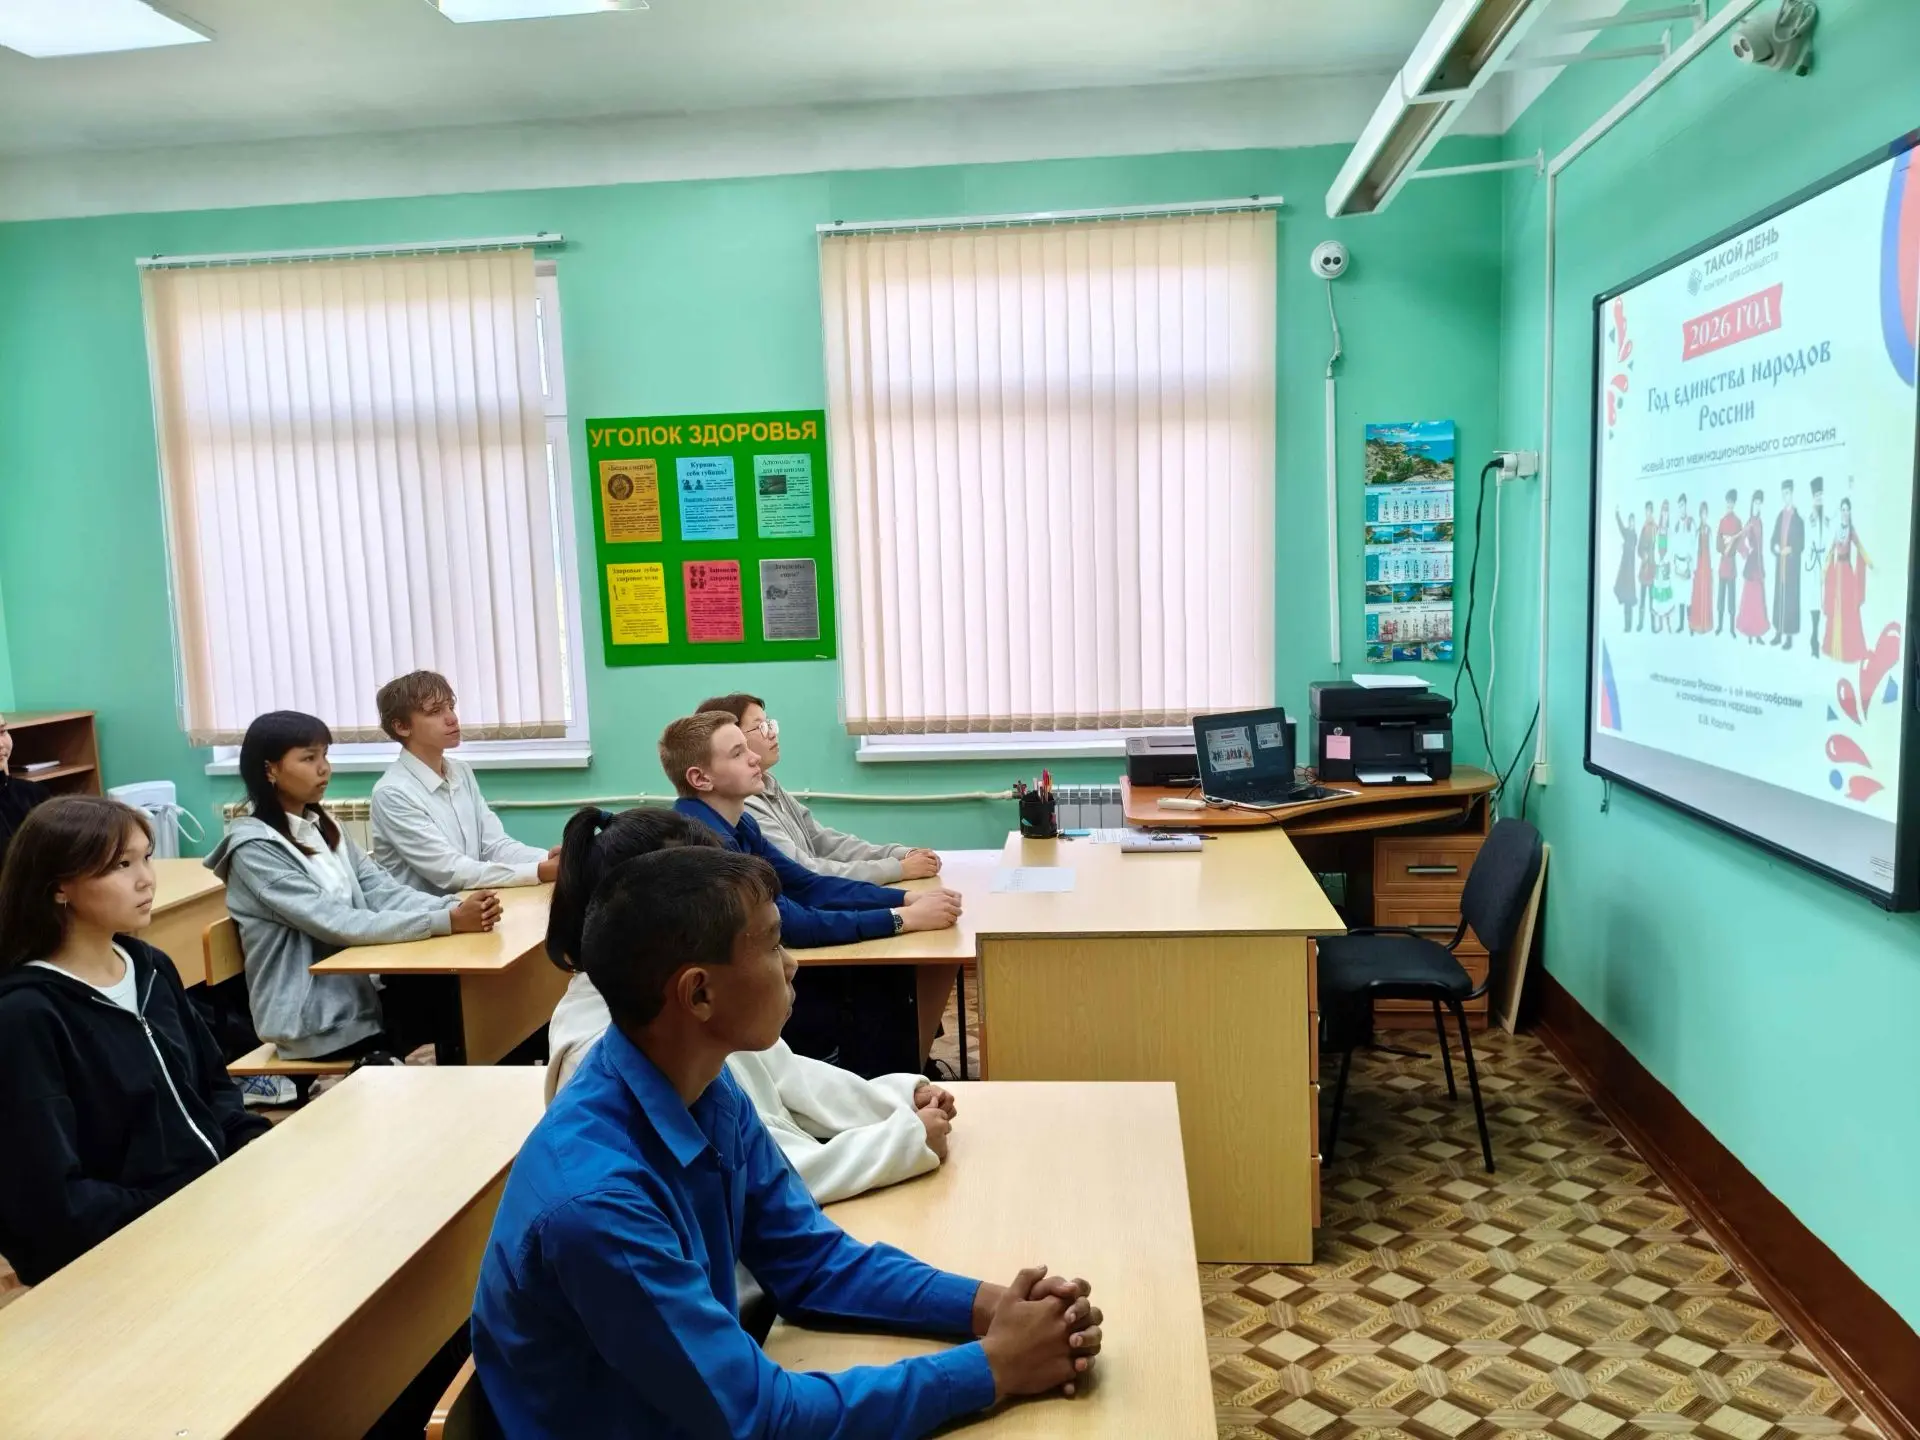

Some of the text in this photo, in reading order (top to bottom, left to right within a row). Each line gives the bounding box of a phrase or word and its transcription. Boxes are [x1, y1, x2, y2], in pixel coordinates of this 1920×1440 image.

[1704, 227, 1779, 276] ТАКОЙ ДЕНЬ
[1689, 296, 1772, 350] 2026 ГОД
[1648, 340, 1831, 414] Год единства народов
[589, 420, 818, 448] УГОЛОК ЗДОРОВЬЯ
[1698, 400, 1755, 431] России
[1641, 427, 1836, 473] новый этап межнационального согласия
